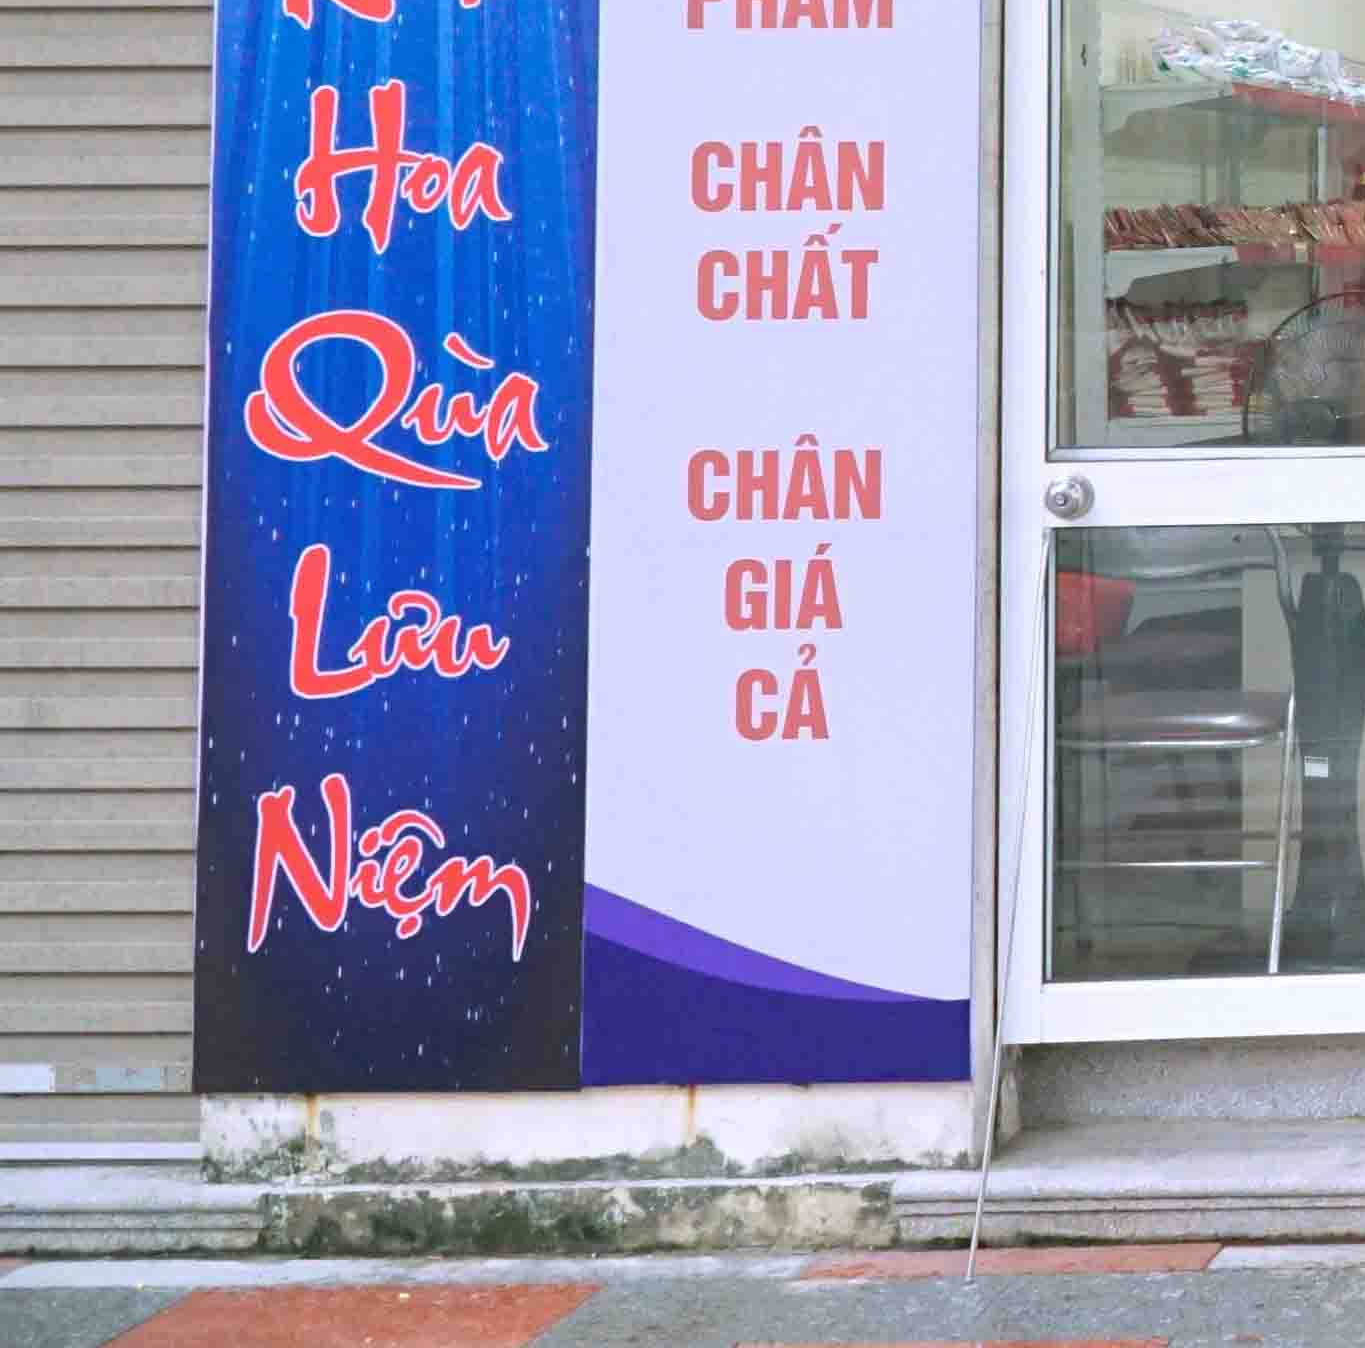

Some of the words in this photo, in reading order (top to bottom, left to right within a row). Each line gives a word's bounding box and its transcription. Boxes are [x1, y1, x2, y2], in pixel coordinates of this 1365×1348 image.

[293, 78, 511, 255] Hoa
[692, 126, 884, 212] CHÂN
[698, 223, 878, 321] CHẤT
[244, 309, 549, 490] Quà
[688, 434, 881, 521] CHÂN
[288, 543, 510, 699] Lưu
[725, 543, 842, 631] GIÁ
[736, 644, 829, 740] CẢ
[248, 773, 531, 964] Niệm
